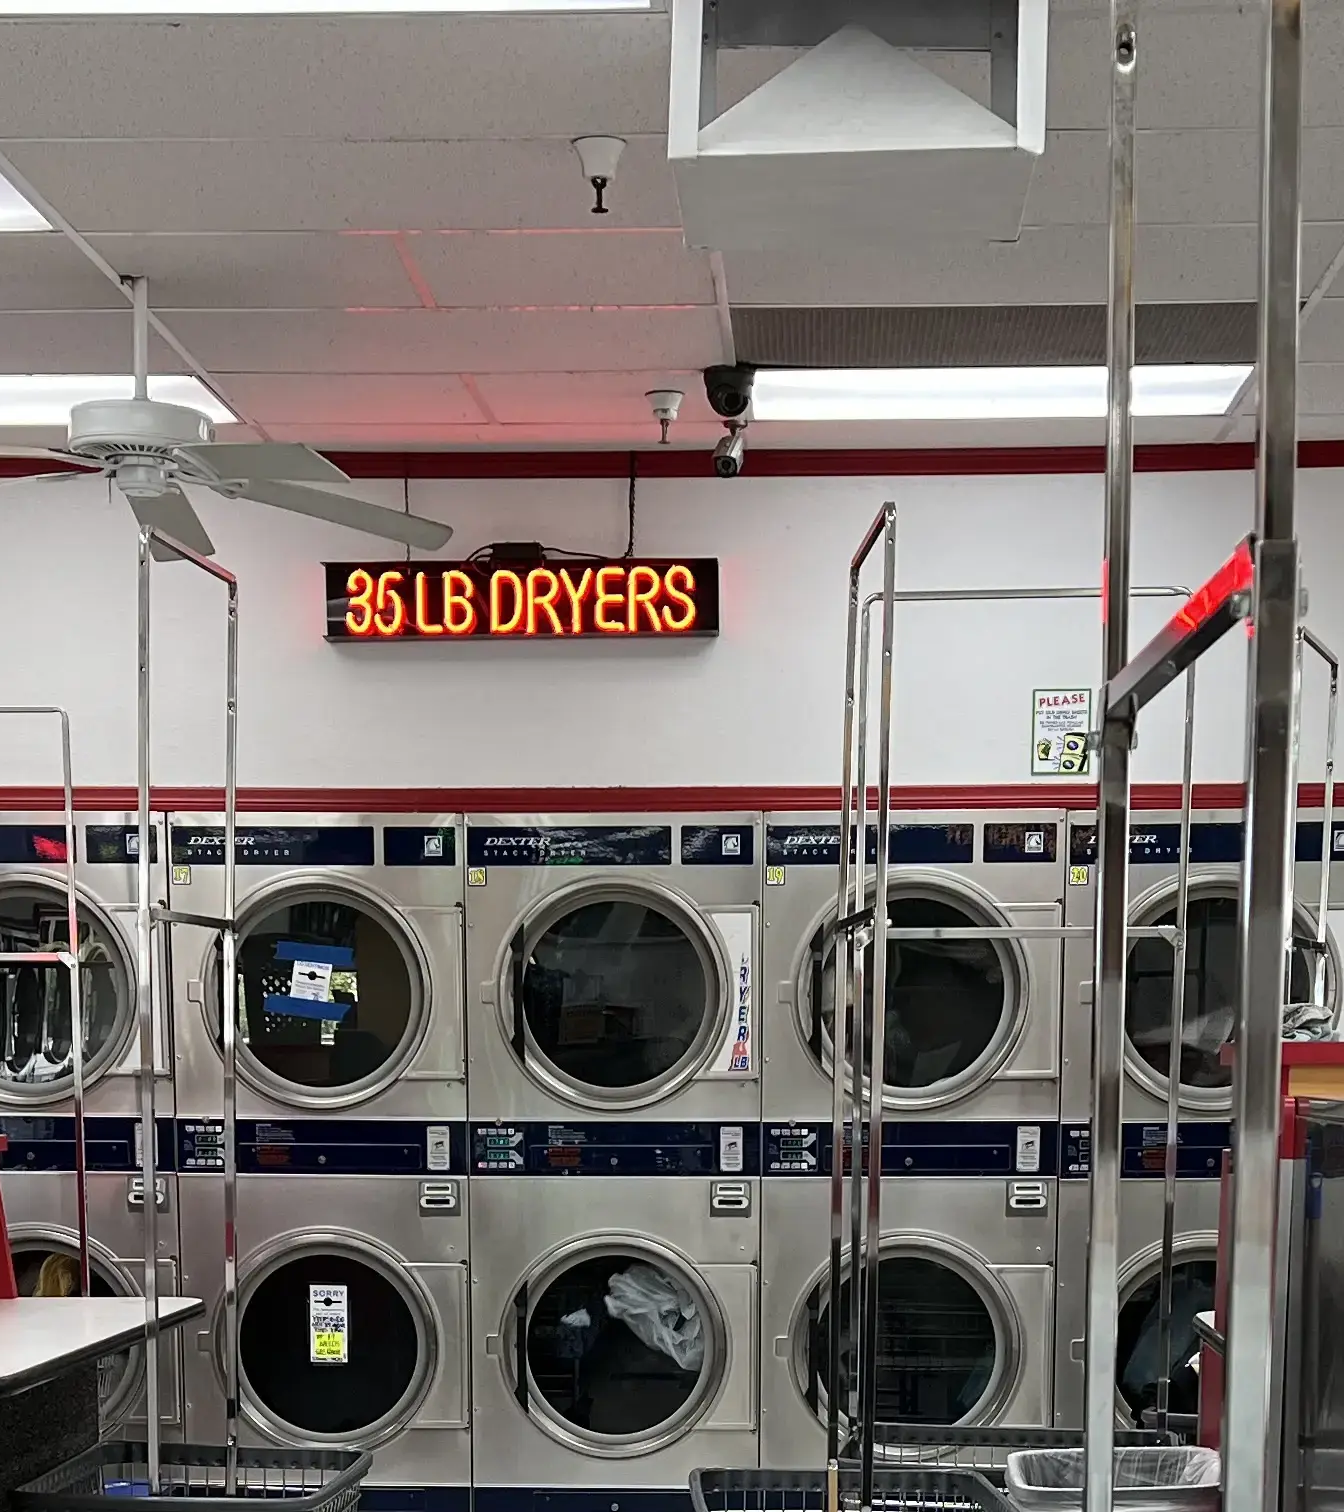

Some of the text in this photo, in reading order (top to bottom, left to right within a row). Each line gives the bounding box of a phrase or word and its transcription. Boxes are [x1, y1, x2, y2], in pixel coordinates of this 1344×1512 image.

[346, 565, 696, 634] 35 LB DRYERS
[1039, 693, 1086, 707] PLEASE
[188, 836, 255, 846] DEXER
[484, 837, 551, 846] DEXTER
[783, 836, 841, 845] DEXTE
[174, 867, 189, 883] 17
[468, 868, 485, 884] 18
[767, 867, 783, 884] 19
[1071, 866, 1086, 884] 20
[733, 1057, 748, 1069] LB
[313, 1290, 344, 1298] SORRY
